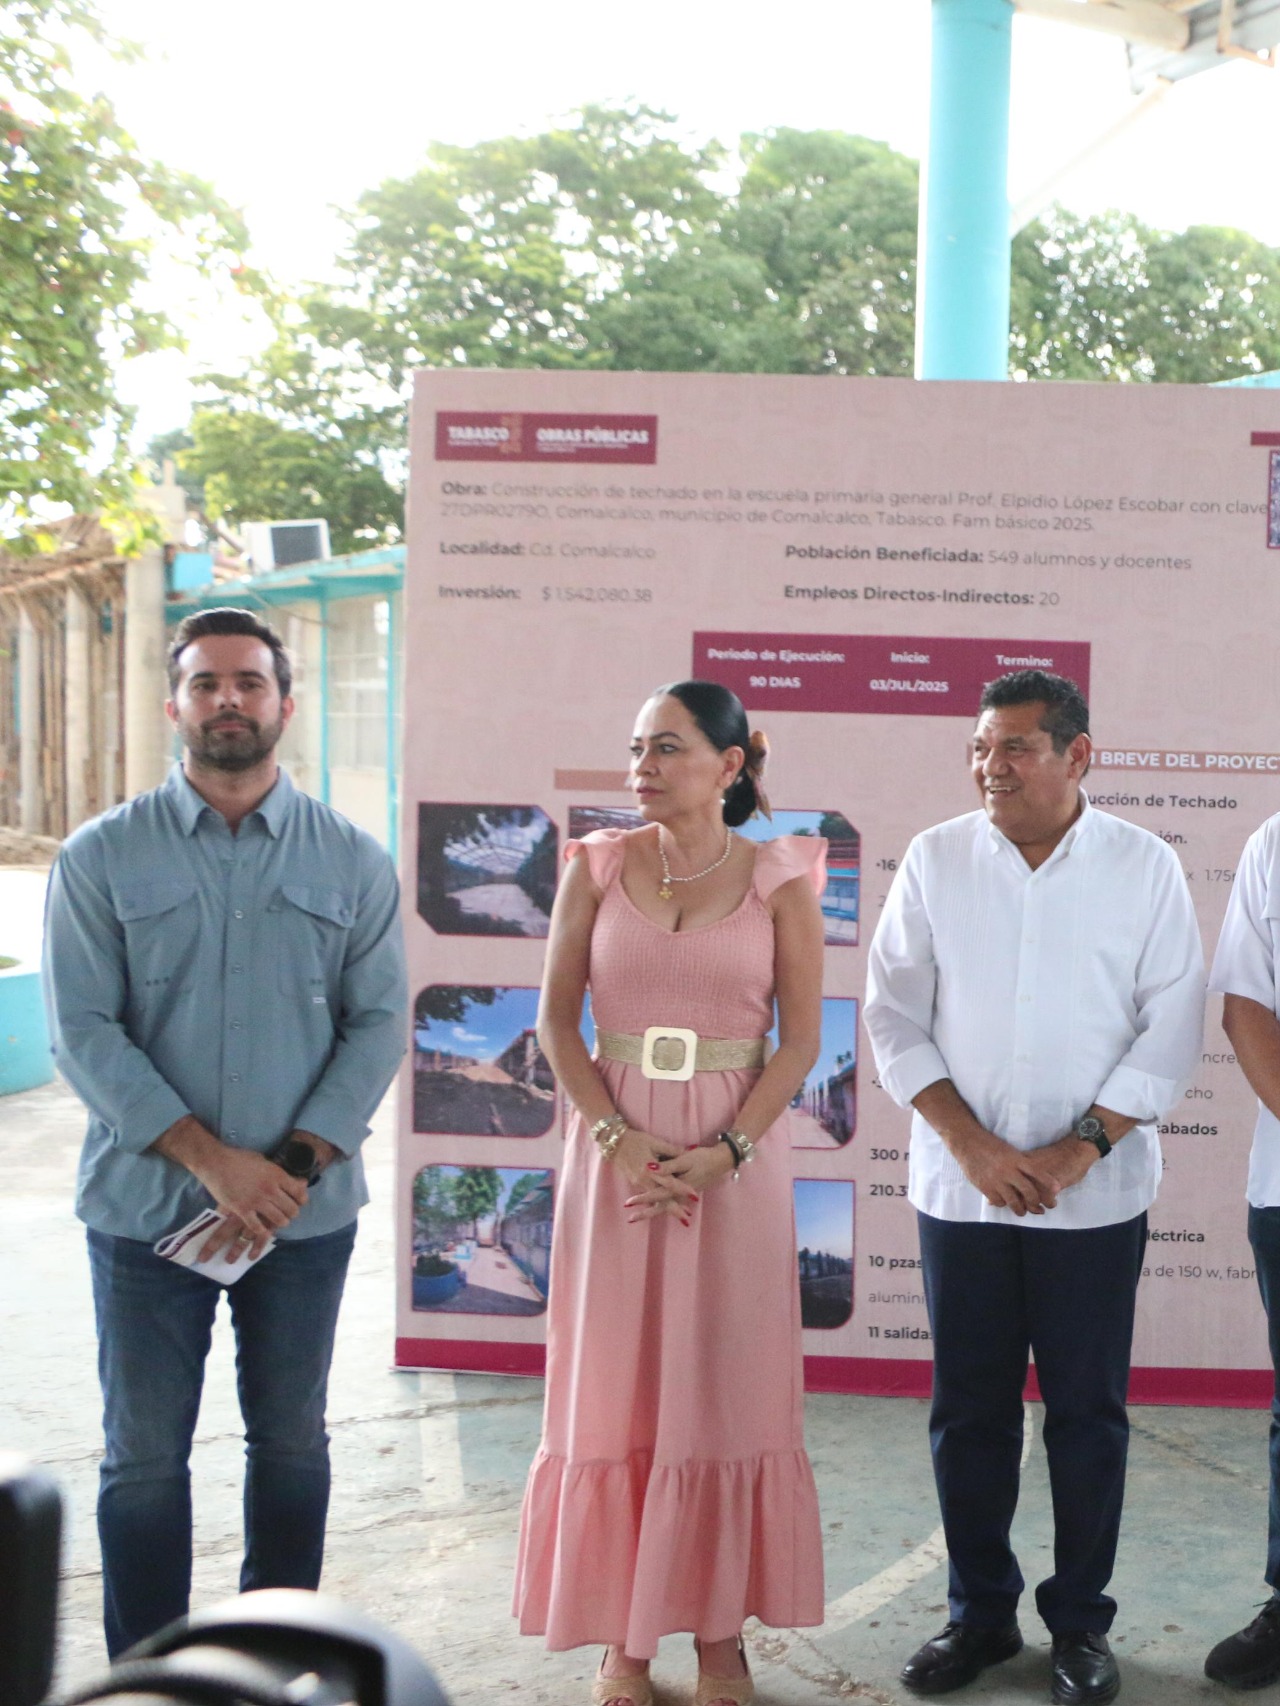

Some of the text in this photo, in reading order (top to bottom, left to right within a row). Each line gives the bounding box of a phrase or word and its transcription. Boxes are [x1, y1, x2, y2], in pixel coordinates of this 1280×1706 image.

[448, 427, 510, 440] TABASCO
[537, 425, 649, 443] OBRAS PÚBLICAS
[441, 481, 487, 496] Obra:
[492, 482, 600, 498] Construcción
[604, 485, 625, 498] de
[629, 486, 697, 500] techado
[703, 490, 723, 500] en
[728, 487, 742, 501] la
[747, 488, 810, 502] escuela
[814, 490, 884, 505] primaria
[888, 492, 952, 507] general
[1001, 493, 1059, 510] Elpidio
[1063, 494, 1113, 512] López
[1118, 496, 1183, 513] Escobar
[1189, 500, 1221, 514] con
[1225, 498, 1268, 514] clave
[659, 507, 743, 524] municipio
[747, 509, 768, 523] de
[952, 513, 991, 528] Fam
[995, 512, 1049, 530] básico
[440, 541, 526, 557] Localidad:
[560, 542, 656, 559] Comalcalco
[785, 544, 1193, 570] Población Beneficiada: 549 alumnos y docentes
[438, 584, 521, 601] Inversión:
[784, 585, 1061, 606] Empleos Directos-Indirectos: 20
[708, 648, 845, 664] Periodo de Ejecución:
[890, 651, 931, 664] Inicio:
[995, 653, 1054, 668] Termino:
[749, 675, 801, 689] 90 DIAS
[869, 678, 949, 693] 03/JUL/2025
[1101, 751, 1160, 767] BREVE
[1165, 753, 1201, 768] DEL
[1144, 794, 1165, 807] de
[1168, 794, 1238, 809] Techado
[870, 1148, 899, 1161] 300
[869, 1183, 908, 1197] 210.3
[868, 1255, 885, 1268] 10
[1155, 1264, 1175, 1278] de
[1178, 1265, 1202, 1279] 150
[867, 1325, 932, 1341] 11 salida
